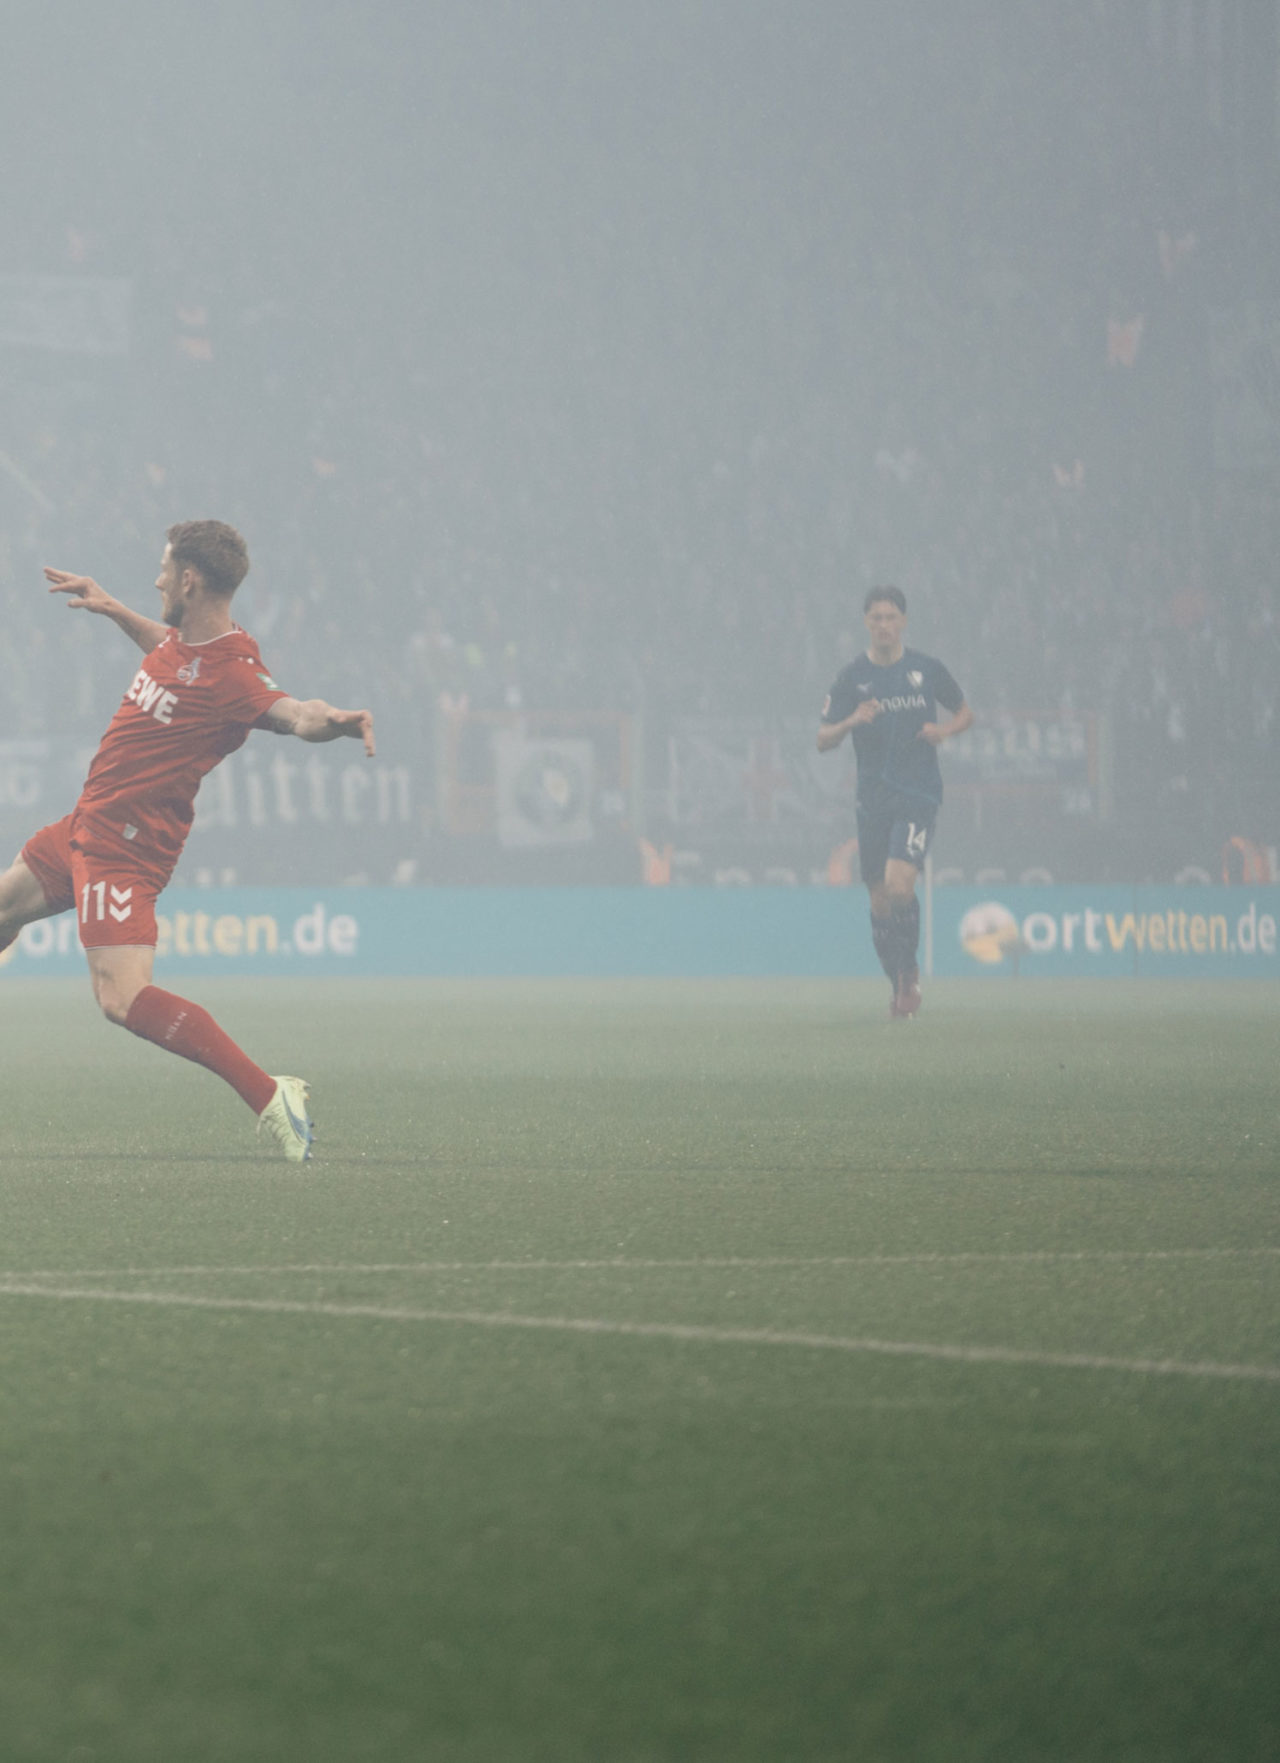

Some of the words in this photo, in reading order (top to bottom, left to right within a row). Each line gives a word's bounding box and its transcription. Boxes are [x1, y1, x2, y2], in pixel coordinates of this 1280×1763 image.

[127, 669, 179, 725] EWE
[906, 822, 927, 852] 14
[81, 880, 107, 924] 11
